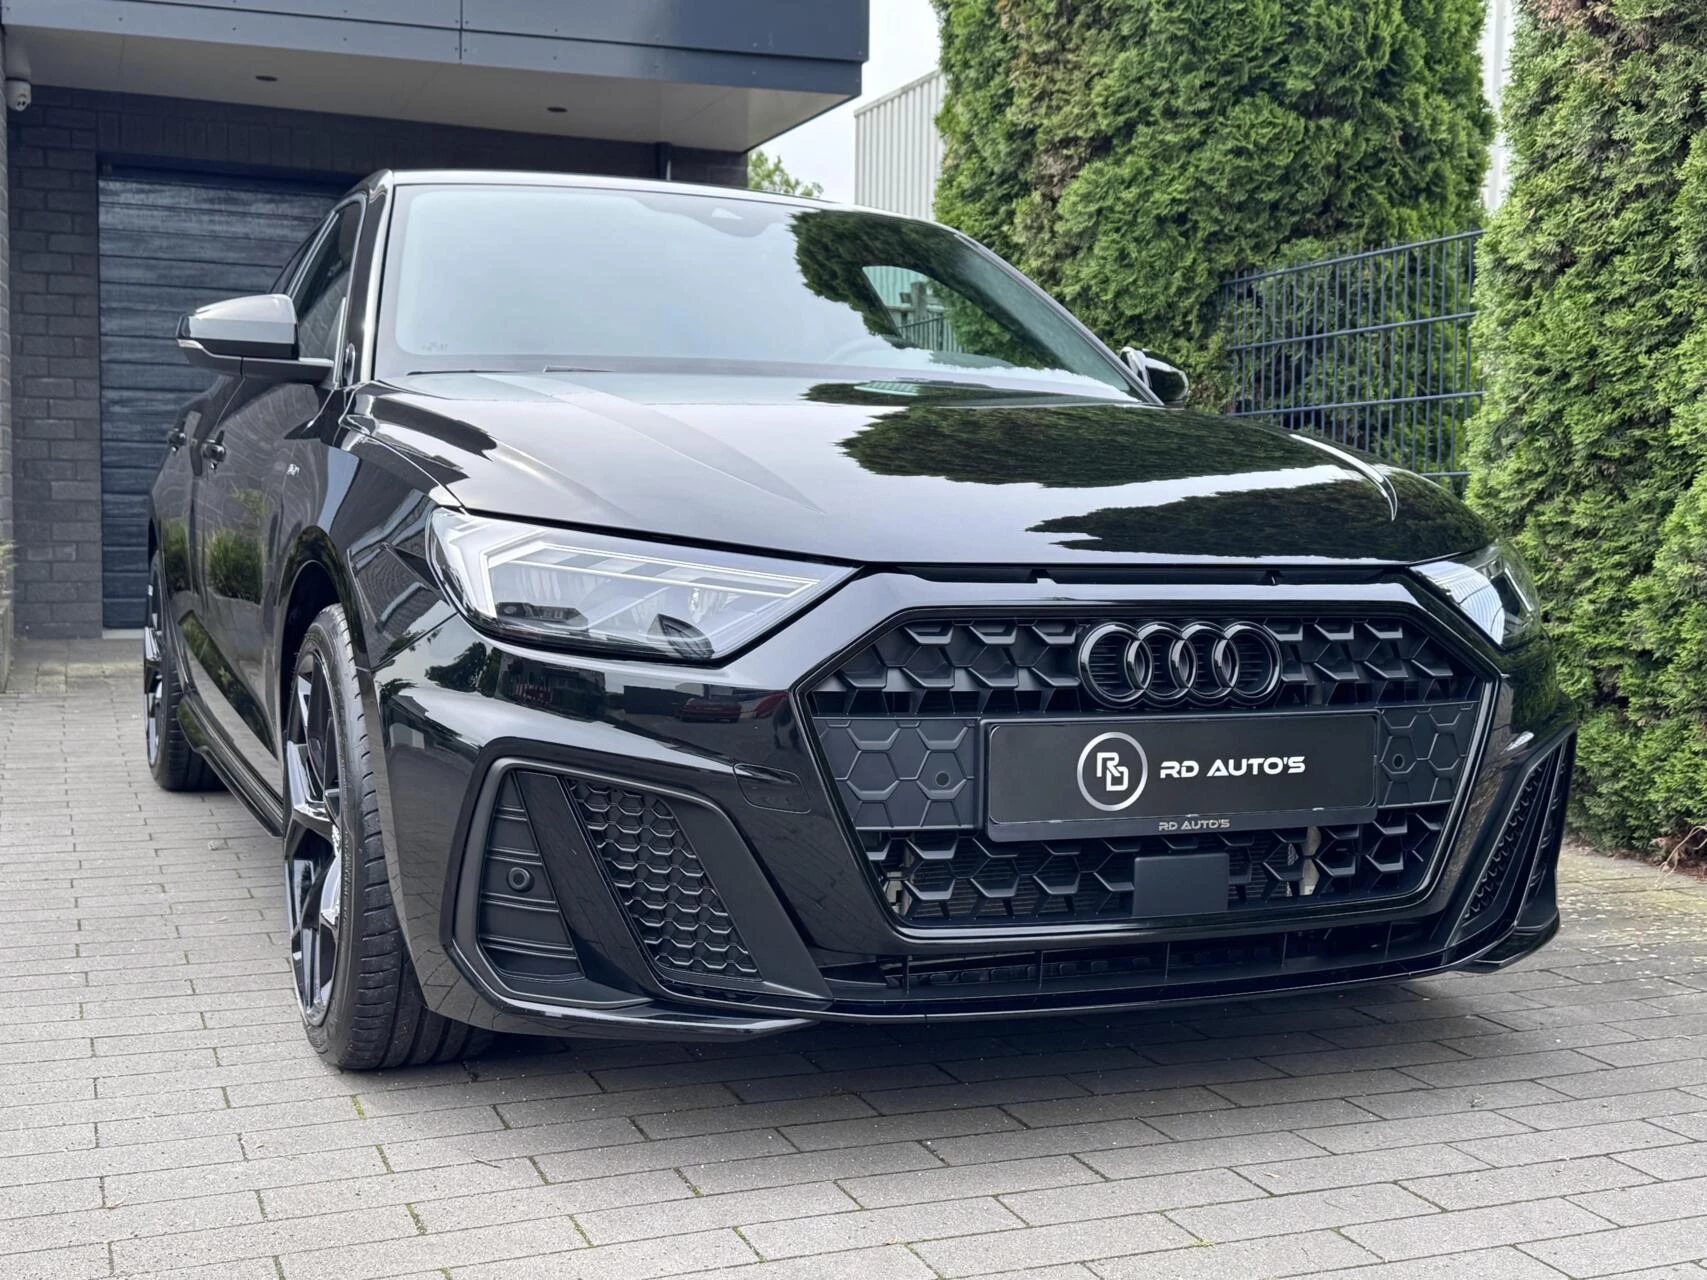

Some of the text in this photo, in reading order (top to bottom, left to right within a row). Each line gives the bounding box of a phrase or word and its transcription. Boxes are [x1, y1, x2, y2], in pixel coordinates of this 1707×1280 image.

[1159, 755, 1306, 779] RD AUTO'S
[1158, 819, 1231, 832] RD AUTO'S
